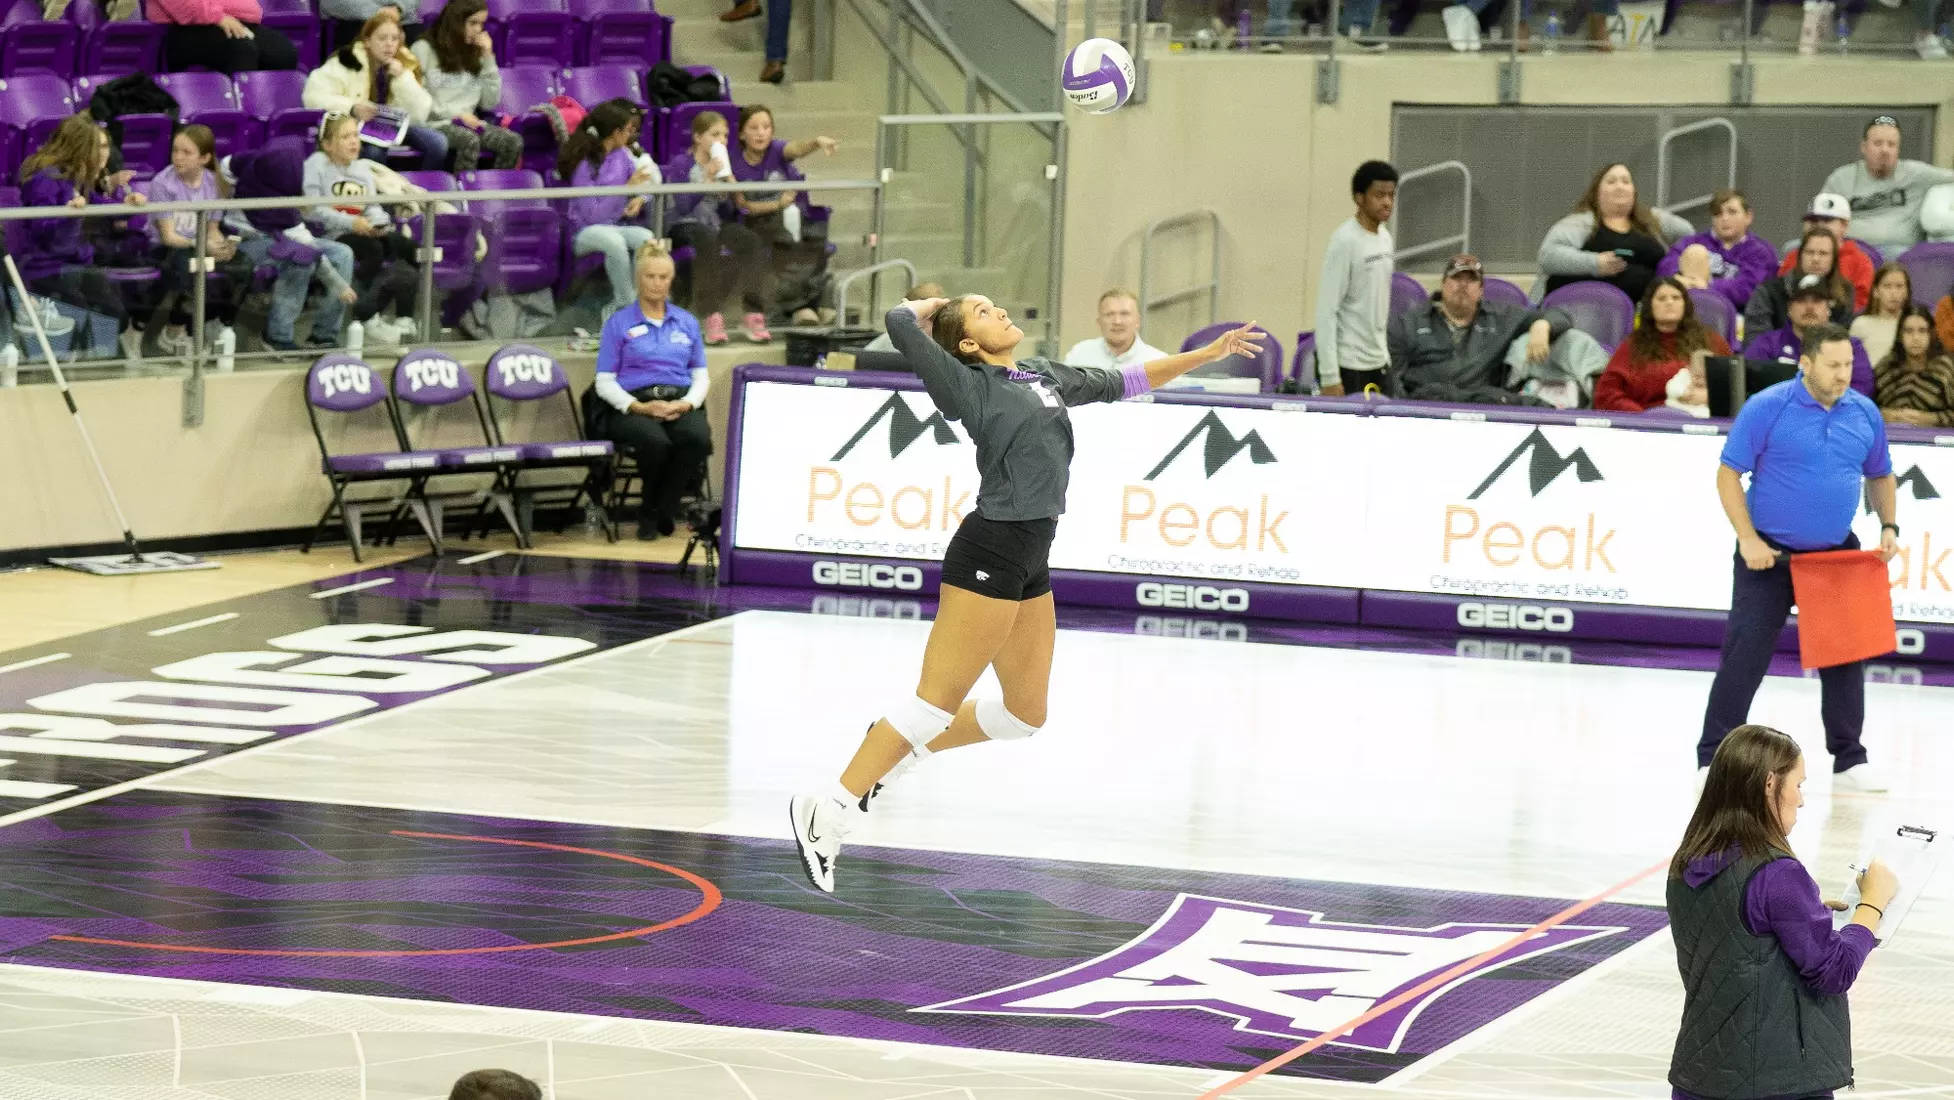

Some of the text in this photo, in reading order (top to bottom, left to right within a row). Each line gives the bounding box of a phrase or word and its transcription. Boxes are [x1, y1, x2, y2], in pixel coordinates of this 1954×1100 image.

[1122, 62, 1135, 85] TCU
[1069, 90, 1099, 102] Baden
[318, 364, 371, 398] TCU
[405, 358, 459, 392] TCU
[496, 354, 552, 387] TCU
[807, 466, 971, 531] Peak
[1119, 484, 1290, 554] Peak
[894, 542, 927, 555] and
[1443, 503, 1617, 573] Peak
[812, 560, 924, 590] GEICO
[1210, 562, 1243, 576] and
[1136, 582, 1249, 612] GEICO
[1536, 583, 1570, 597] and
[1456, 602, 1574, 632] GEICO
